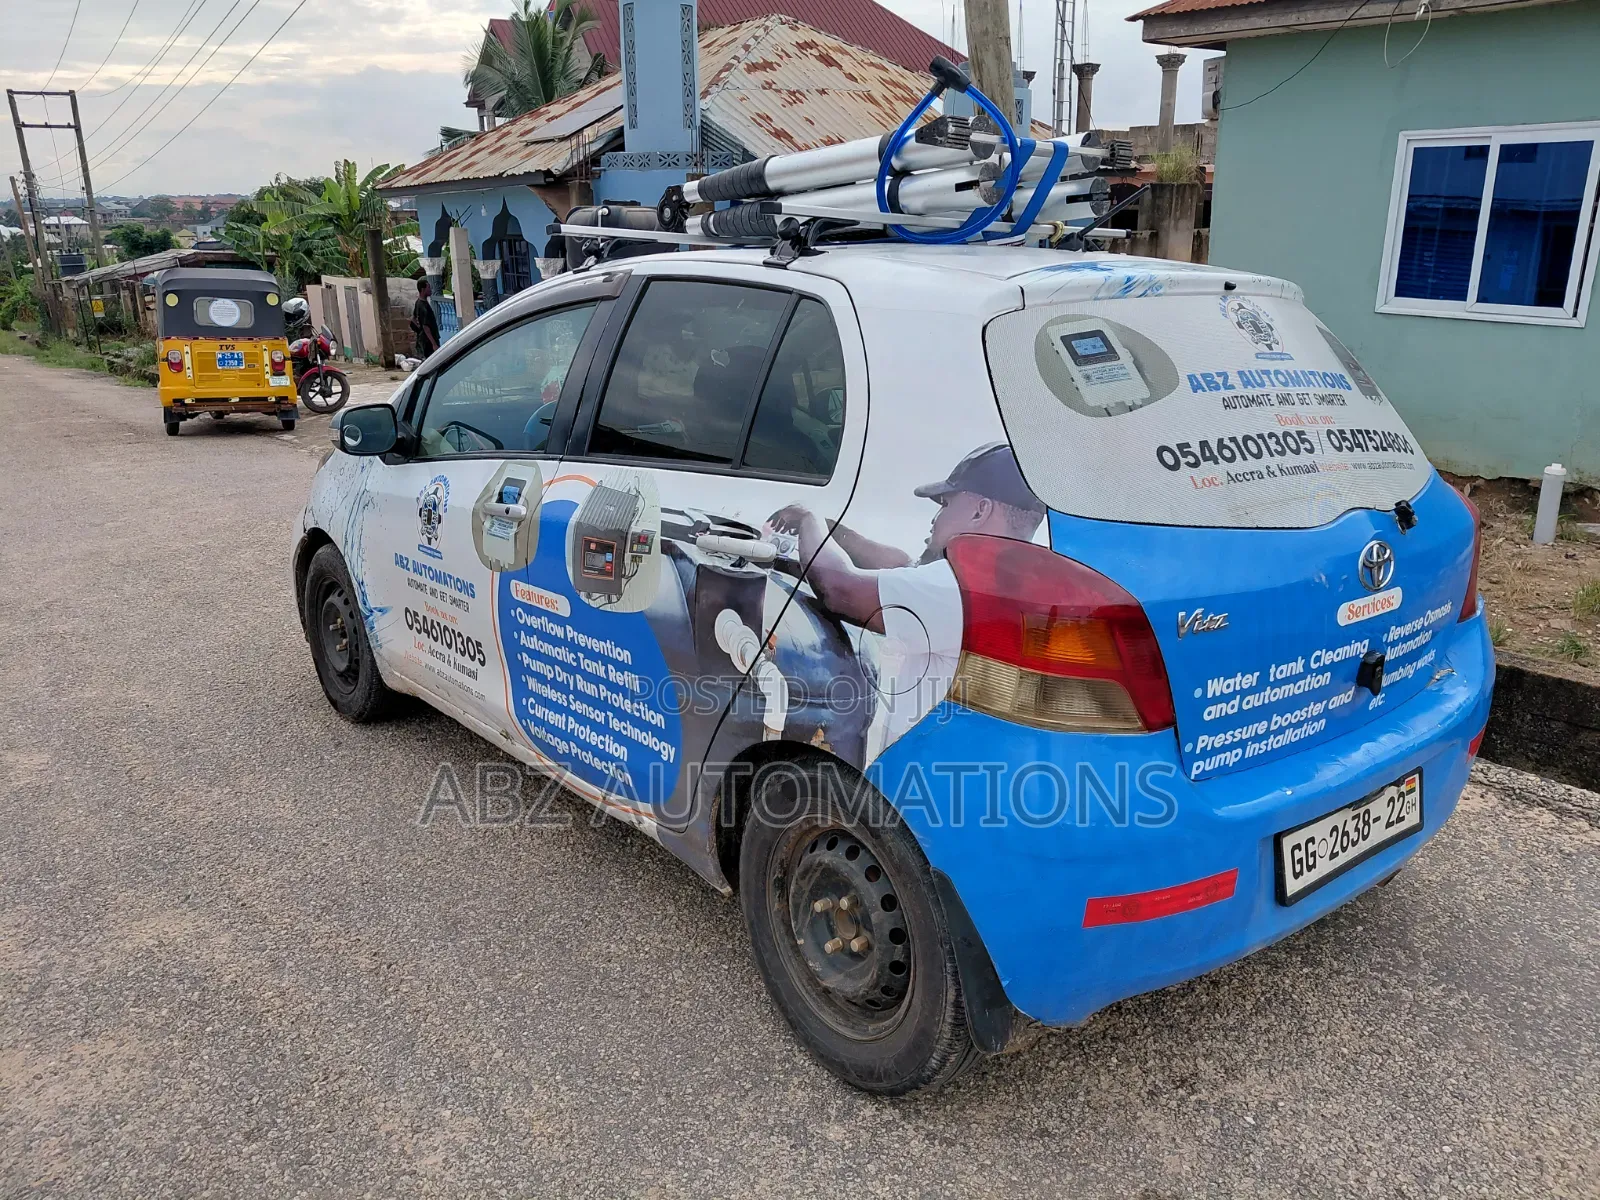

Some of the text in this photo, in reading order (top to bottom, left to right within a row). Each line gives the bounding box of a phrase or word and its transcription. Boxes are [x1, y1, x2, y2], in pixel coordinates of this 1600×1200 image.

[1187, 369, 1352, 394] ABZ AUTOMATIONS
[1222, 393, 1348, 410] AUTOMATE AND GET SMARTER
[1275, 413, 1304, 427] Book
[1306, 416, 1318, 425] us
[1156, 430, 1315, 472] 0546101305
[1326, 428, 1415, 456] 0547524806
[1190, 474, 1224, 490] Loc.
[1226, 470, 1265, 485] Accra
[1266, 467, 1277, 479] &
[1277, 460, 1320, 478] Kumasi
[394, 552, 411, 572] ABZ
[412, 560, 476, 599] AUTOMATIONS
[407, 577, 470, 613] AUTOMATE AND GET SMARTER
[514, 582, 559, 612] Features:
[1177, 607, 1230, 640] Vitz
[1347, 594, 1395, 621] Services:
[1388, 600, 1452, 643] Reverse Osmosis
[404, 606, 487, 667] 0546101305
[413, 636, 427, 653] Loc.
[427, 644, 446, 664] Accra
[453, 656, 478, 681] Kumasi
[516, 607, 633, 666] Overflow Prevention
[1385, 630, 1433, 662] Automation
[519, 630, 640, 694] Automatic Tank Refill
[1206, 637, 1369, 699] Water tank Cleaning
[1382, 660, 1417, 688] lumbing
[522, 653, 666, 730] Pump Dry Run Protection
[1203, 671, 1331, 722] and automation
[526, 676, 676, 764] Wireless Sensor Technology
[527, 697, 628, 762] Current Protection
[1195, 686, 1355, 754] Pressure booster and
[569, 741, 633, 787] Protection
[1190, 718, 1326, 780] pump installation
[1290, 836, 1317, 881] GG
[1405, 797, 1417, 814] GH
